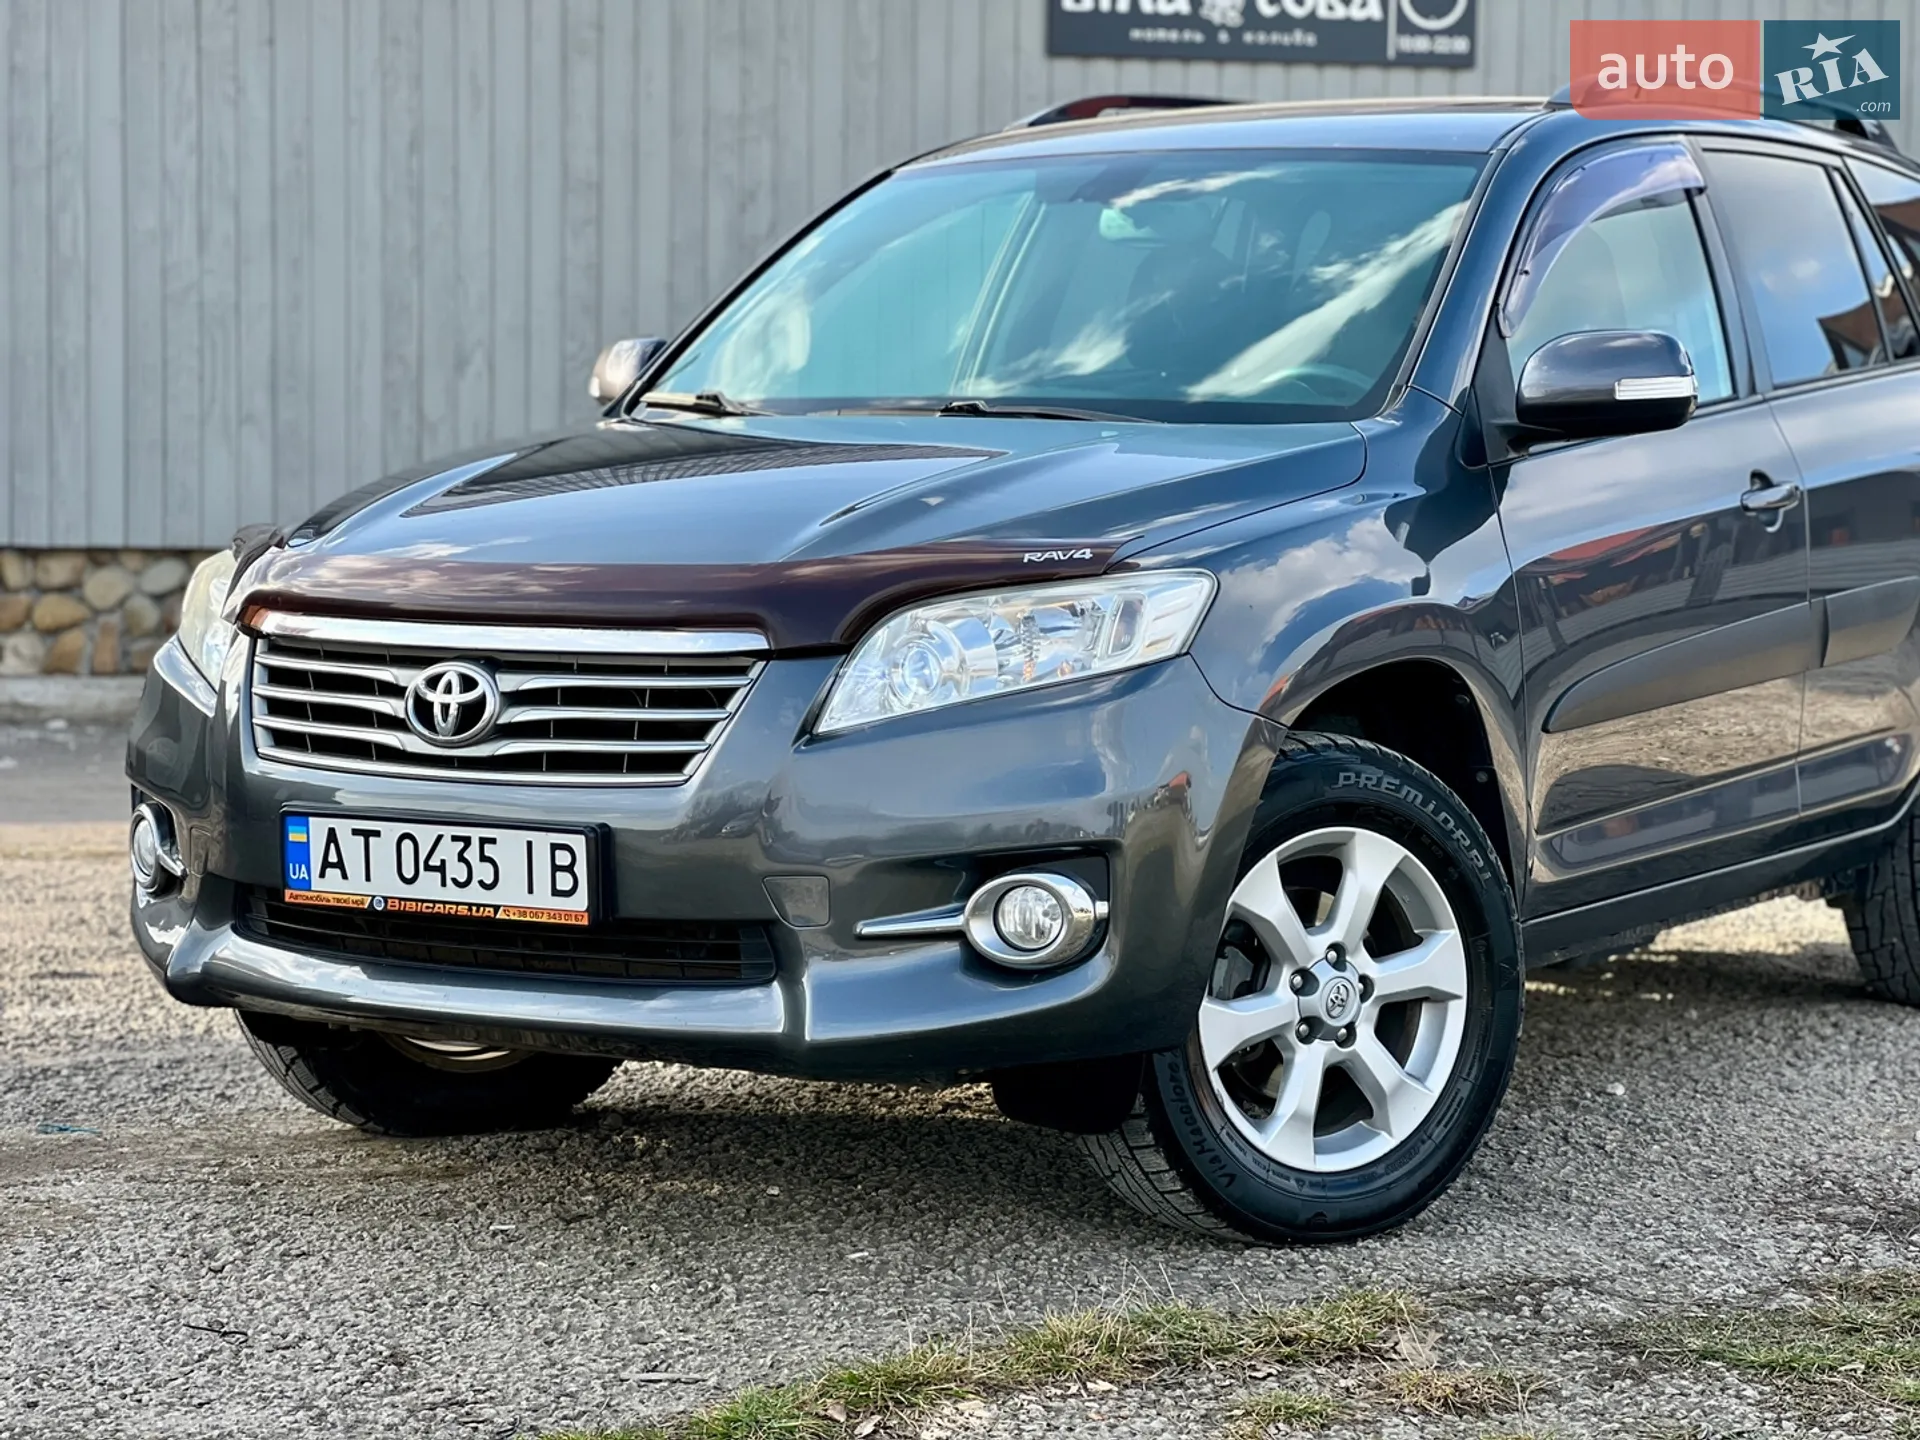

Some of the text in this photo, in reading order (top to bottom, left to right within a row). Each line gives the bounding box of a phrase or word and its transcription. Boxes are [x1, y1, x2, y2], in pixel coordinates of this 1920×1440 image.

[1023, 548, 1093, 563] RAV4
[318, 827, 579, 898] AT 0435 IB
[289, 863, 309, 880] UA
[288, 892, 331, 904] Автомобіль
[387, 898, 495, 918] BIBICARS.UA
[512, 909, 585, 922] +38 067 343 01 67
